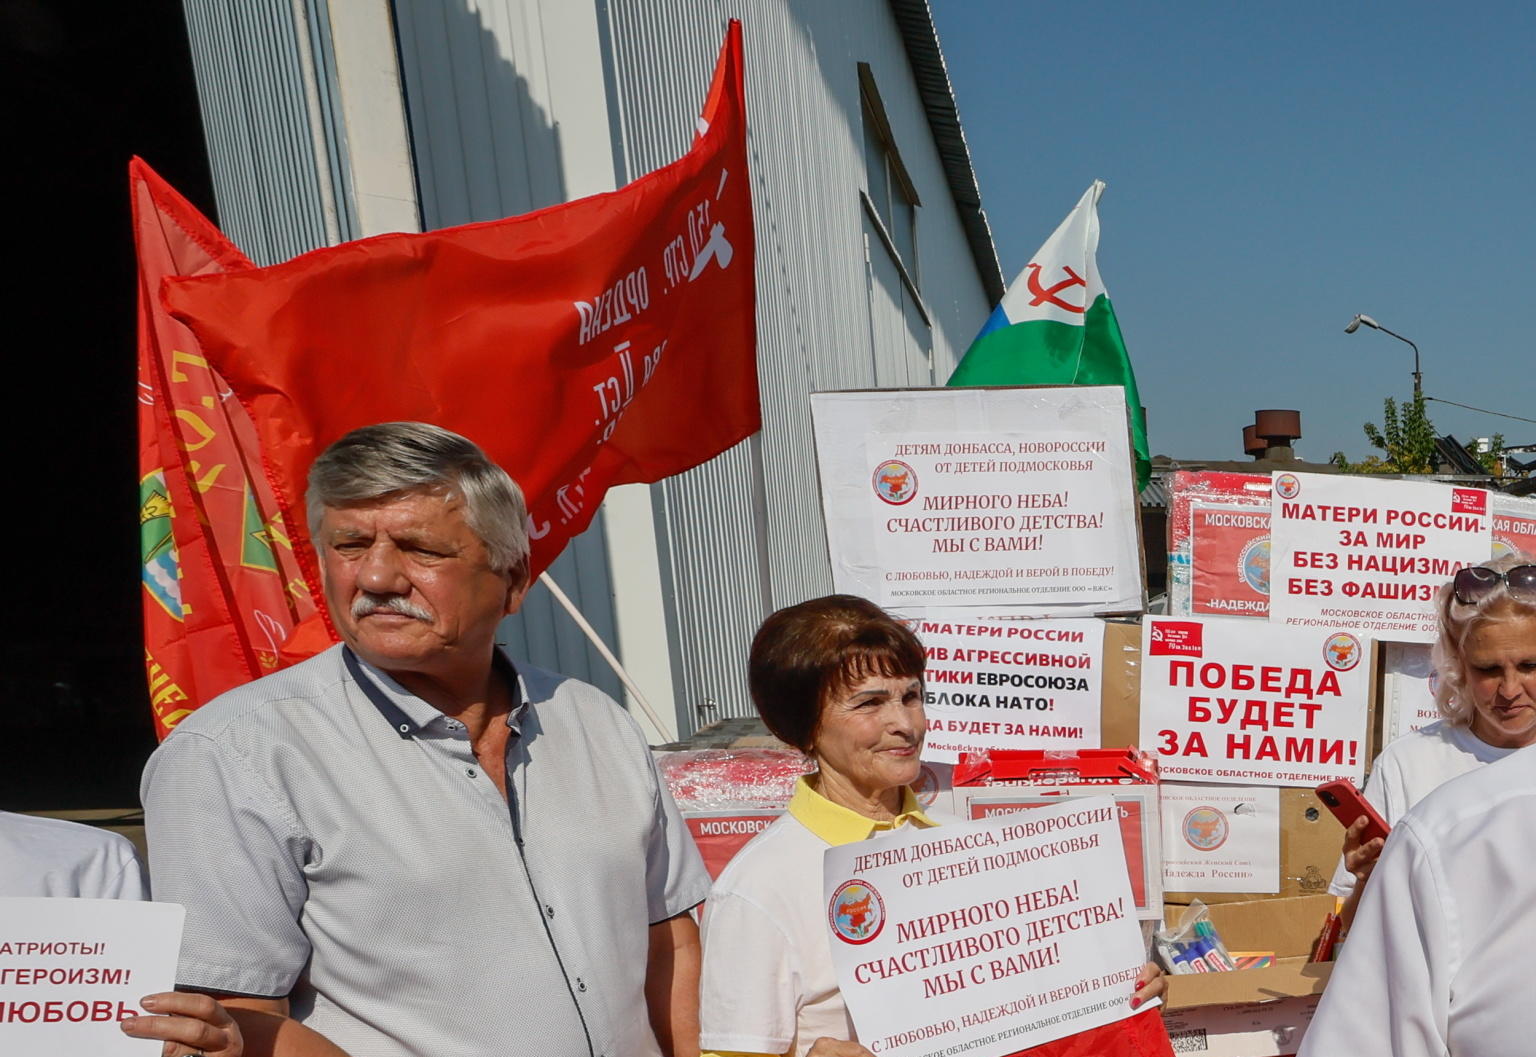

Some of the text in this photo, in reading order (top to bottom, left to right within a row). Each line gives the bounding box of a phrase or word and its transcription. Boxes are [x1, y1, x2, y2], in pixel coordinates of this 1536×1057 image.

[895, 441, 1105, 457] ДЕТЯМ ДОНБАССА, НОВОРОССИИ
[935, 458, 1093, 474] ОТ ДЕТЕЙ ПОДМОСКОВЬЯ
[923, 492, 1069, 511] МИРНОГО НЕБА!
[886, 512, 1104, 533] СЧАСТЛИВОГО ДЕТСТВА!
[1282, 502, 1377, 524] МАТЕРИ
[932, 535, 1043, 553] МЫ С ВАМИ!
[1339, 530, 1426, 550] ЗА МИР
[1293, 551, 1338, 569] БЕЗ
[886, 566, 1115, 582] С ЛЮБОВЬЮ, НАДЕЖДОЙ И ВЕРОЙ В ПОБЕДУ!
[890, 589, 936, 597] МОСКОВСКОЕ
[937, 588, 976, 596] ОБЛАСТНОЕ
[978, 587, 1030, 595] РЕГИОНАЛЬНОЕ
[1288, 578, 1438, 601] БЕЗ ФАШИЗ
[1321, 608, 1383, 619] МОСКОВСКОЕ
[922, 623, 1084, 643] МАТЕРИ РОССИИ
[1286, 617, 1361, 629] РЕГИОНАЛЬНОЕ
[1363, 621, 1417, 632] ОТДЕЛЕНИЕ
[952, 649, 1091, 669] АГРЕССИВНОЙ
[977, 672, 1089, 691] ЕВРОСОЮЗА
[1169, 660, 1342, 700] ПОБЕДА
[996, 696, 1054, 711] НАТО!
[1188, 696, 1322, 732] БУДЕТ
[947, 720, 1001, 735] БУДЕТ
[1004, 723, 1025, 736] ЗА
[1029, 725, 1083, 739] НАМИ!
[1157, 729, 1357, 765] ЗА НАМИ!
[1216, 769, 1273, 779] ОБЛАСТНОЕ
[1276, 773, 1332, 782] ОТДЕЛЕНИЕ
[853, 807, 1114, 875] ДЕТЯМ ДОНБАССА, НОВОРОССИИ
[902, 833, 1100, 889] ОТ ДЕТЕЙ ПОДМОСКОВЬЯ
[895, 899, 1011, 944] МИРНОГО
[1016, 879, 1080, 917] НЕБА!
[854, 897, 1125, 985] СЧАСТЛИВОГО ДЕТСТВА!
[0, 968, 131, 986] ГЕРОИЗМ!
[922, 942, 1061, 999] МЫ С ВАМИ!
[871, 1040, 881, 1054] С
[884, 1019, 960, 1051] ЛЮБОВЬЮ,
[962, 994, 1036, 1030] НАДЕЖДОЙ
[1038, 993, 1048, 1006] И
[1050, 977, 1090, 1003] ВЕРОЙ
[1092, 976, 1101, 990] В
[946, 1034, 997, 1055] ОБЛАСТНОЕ
[998, 1015, 1060, 1041] РЕГИОНАЛЬНОЕ
[1061, 1001, 1107, 1022] ОТДЕЛЕНИЕ
[1108, 996, 1124, 1008] ООО
